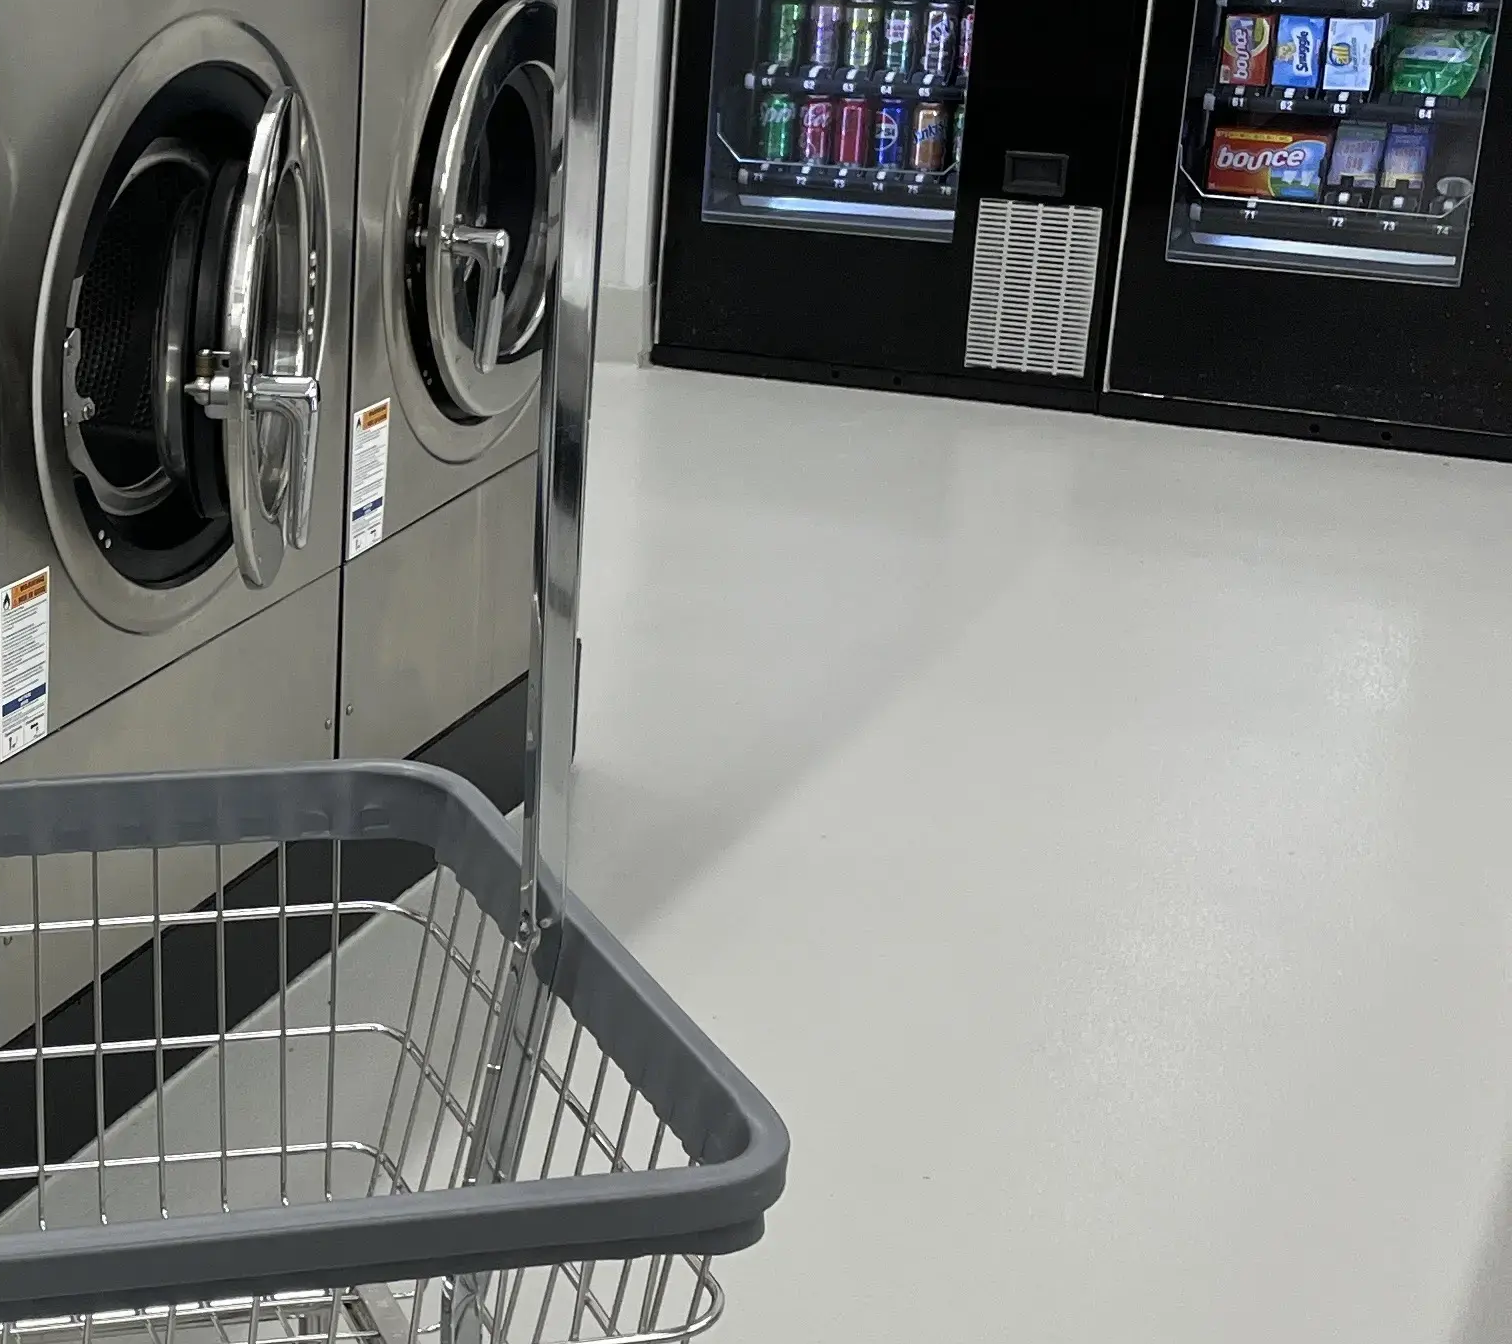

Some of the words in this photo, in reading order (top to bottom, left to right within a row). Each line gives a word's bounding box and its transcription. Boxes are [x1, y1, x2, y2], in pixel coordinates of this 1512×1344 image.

[1416, 0, 1430, 10] 53
[1466, 2, 1480, 12] 54
[1232, 28, 1249, 80] bounce
[1295, 30, 1310, 73] Snuggle
[1231, 97, 1244, 107] 61
[1280, 99, 1293, 111] 62
[1333, 103, 1346, 114] 63
[1419, 108, 1433, 119] 64
[1216, 146, 1306, 171] bounce
[1244, 210, 1256, 219] 71
[1331, 216, 1344, 227] 72
[1382, 221, 1396, 231] 73
[1436, 224, 1449, 236] 74
